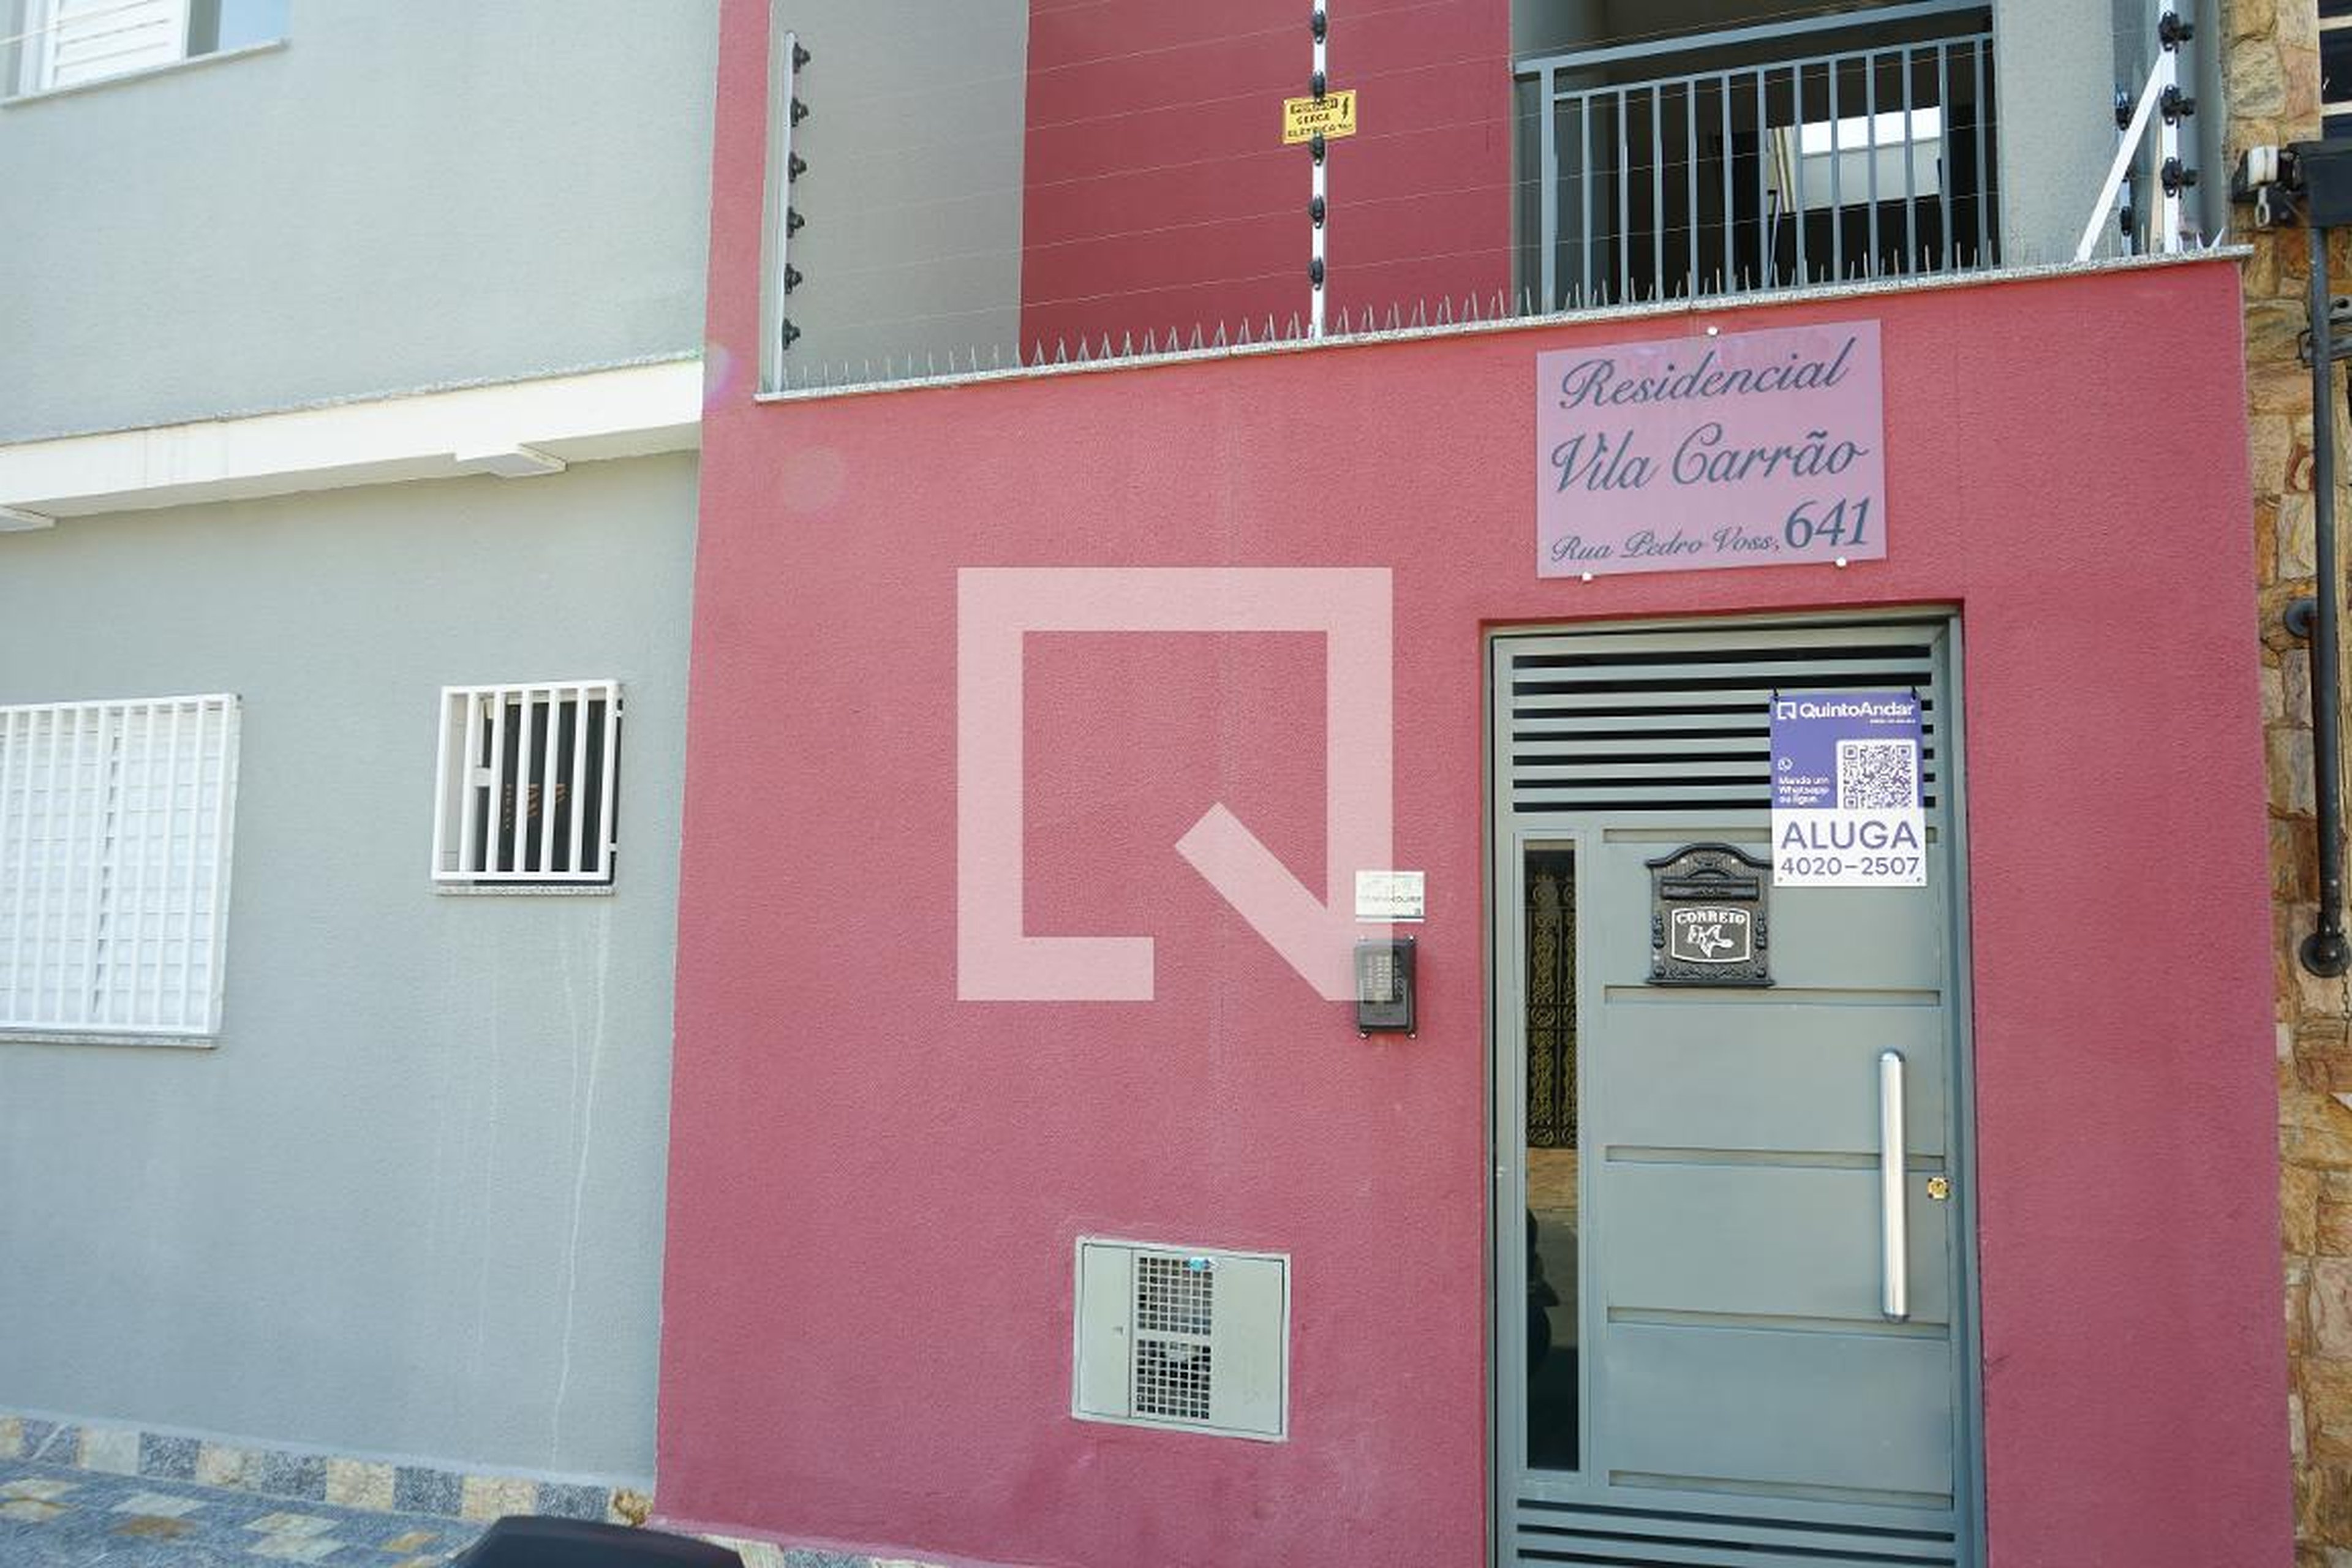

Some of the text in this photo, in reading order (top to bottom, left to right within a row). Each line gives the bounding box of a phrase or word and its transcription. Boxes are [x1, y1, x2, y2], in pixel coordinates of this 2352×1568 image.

[1559, 337, 1856, 409] Residencial
[1551, 423, 1869, 492] Vila Carrão
[1551, 536, 1613, 562] Rua
[1620, 528, 1705, 558] Pedro
[1785, 497, 1870, 549] 641
[1800, 702, 1913, 718] QuintoAndar
[1781, 821, 1918, 850] ALUGA
[1781, 858, 1920, 876] 4020-2507
[1676, 910, 1746, 924] CORREIO
